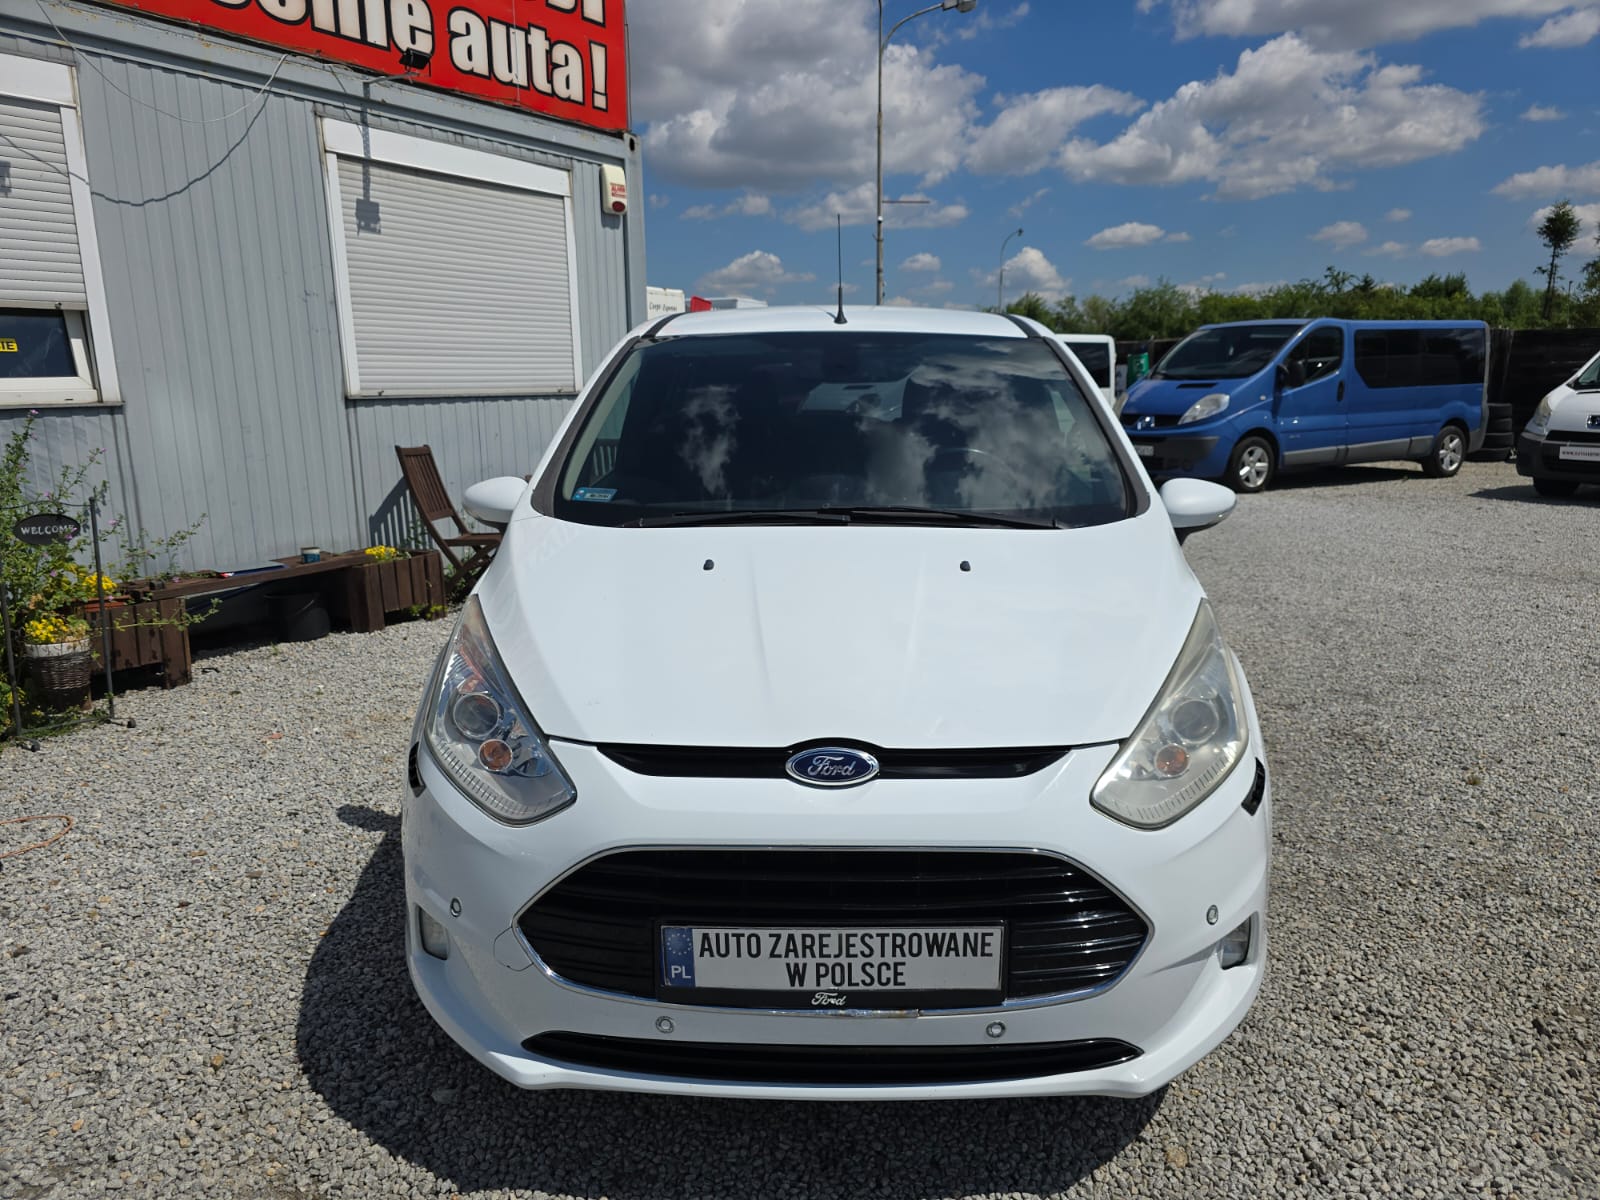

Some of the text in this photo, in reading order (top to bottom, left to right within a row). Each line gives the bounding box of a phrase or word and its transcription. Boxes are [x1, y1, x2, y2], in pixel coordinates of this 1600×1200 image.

[807, 755, 857, 776] Ford
[699, 932, 994, 959] AUTO ZAREJESTROWANE
[671, 965, 692, 979] PL
[785, 962, 906, 987] W POLSCE
[811, 991, 847, 1006] Ford
